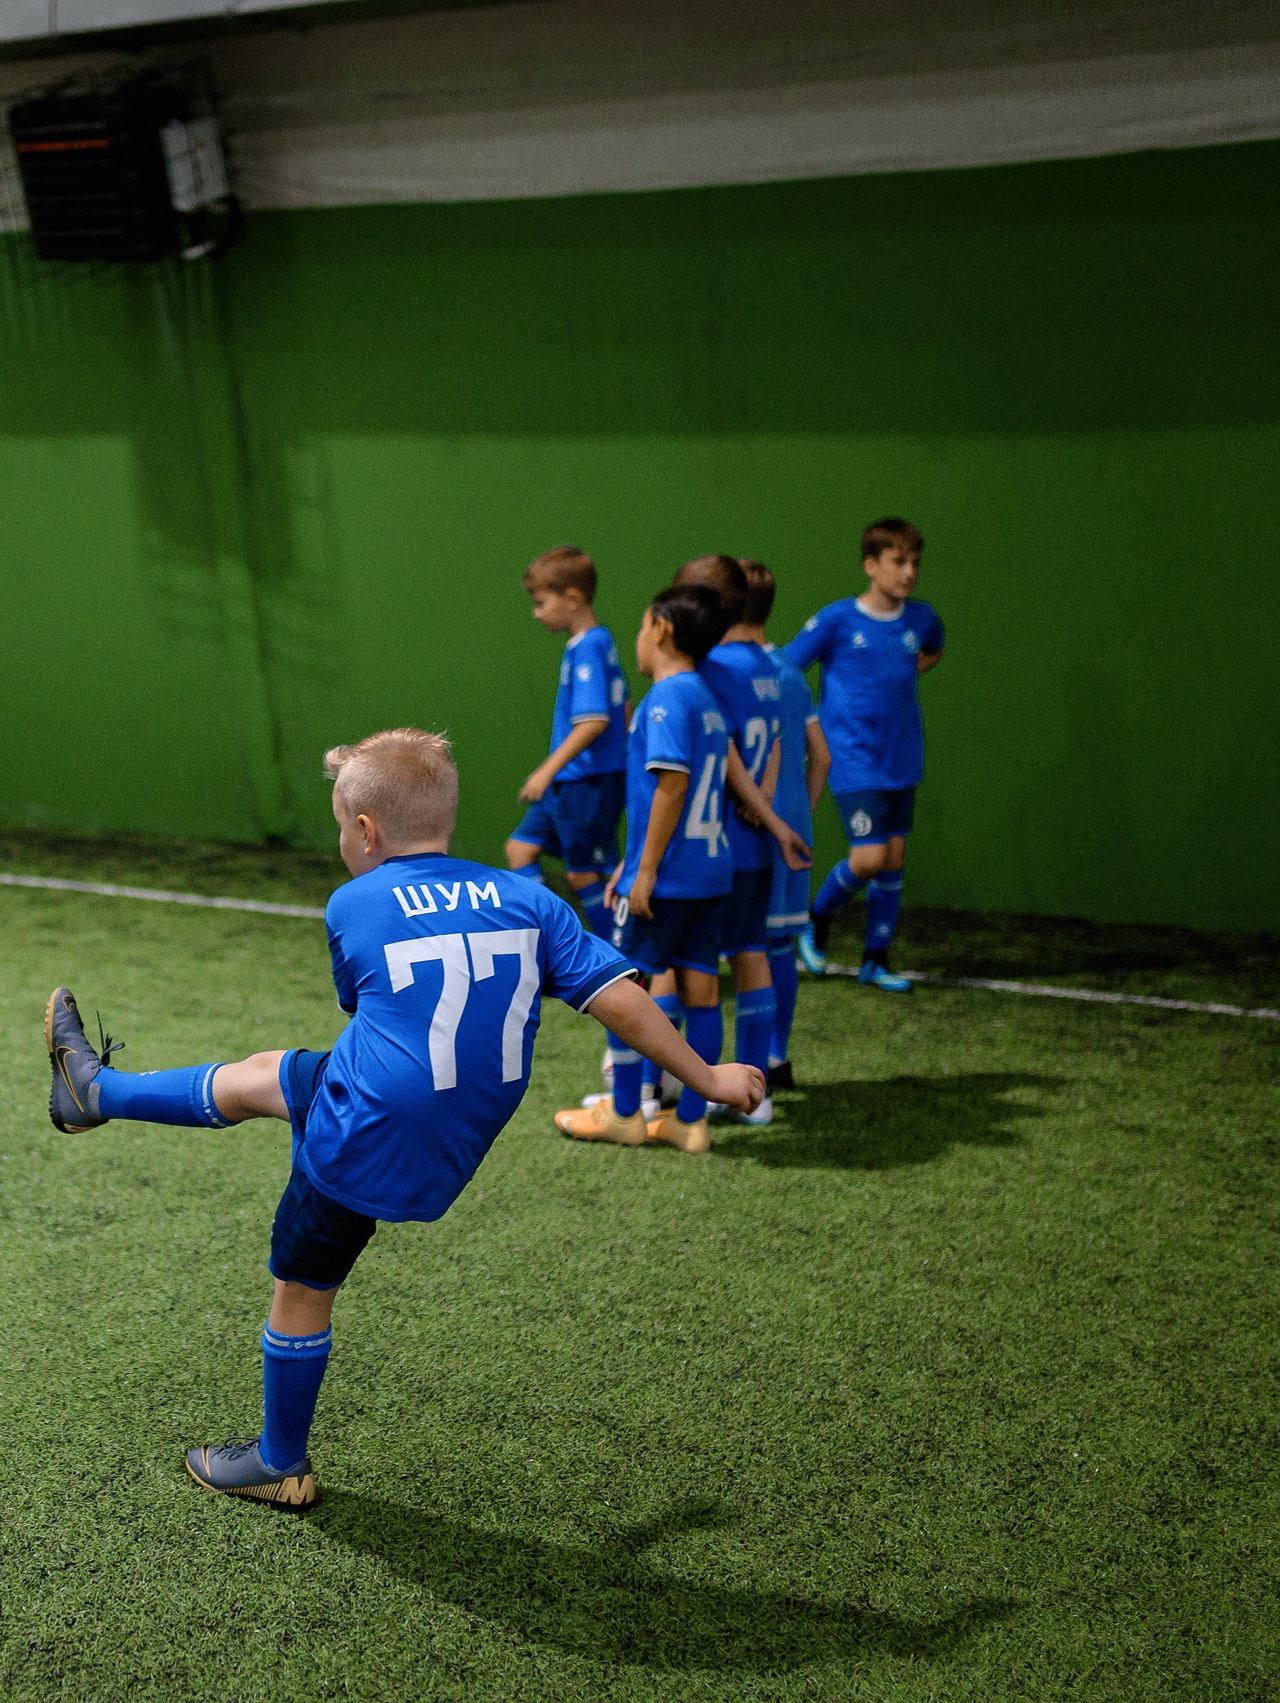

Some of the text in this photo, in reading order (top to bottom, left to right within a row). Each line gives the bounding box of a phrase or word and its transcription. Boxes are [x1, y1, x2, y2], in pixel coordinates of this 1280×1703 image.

[685, 752, 729, 858] 4
[392, 881, 503, 919] ШУМ
[383, 928, 541, 1091] 77
